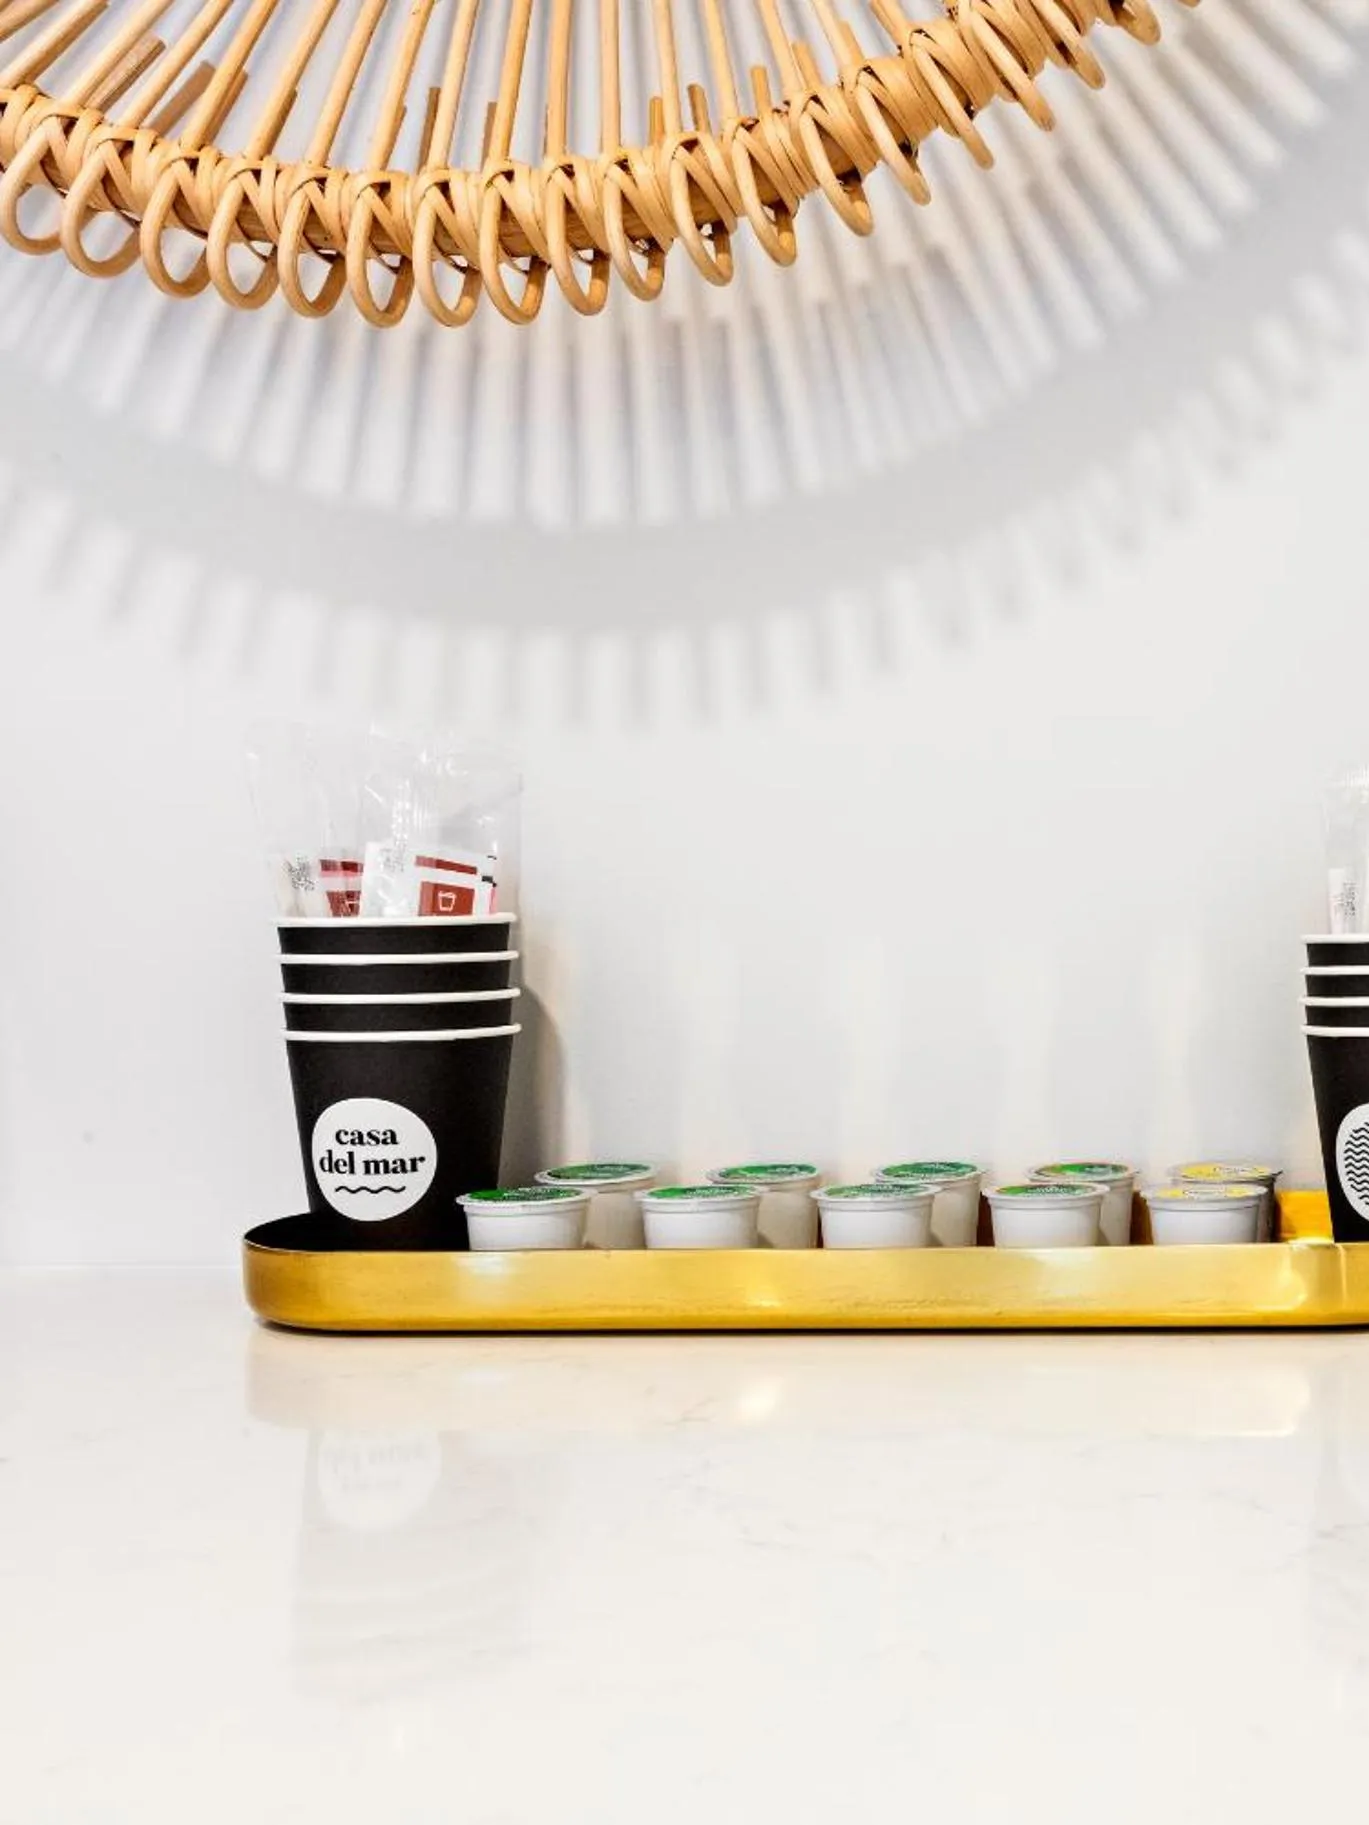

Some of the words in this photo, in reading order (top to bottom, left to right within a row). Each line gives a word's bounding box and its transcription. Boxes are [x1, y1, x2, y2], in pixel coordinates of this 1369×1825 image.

[335, 1128, 399, 1146] casa
[319, 1149, 356, 1175] del
[362, 1156, 426, 1175] mar
